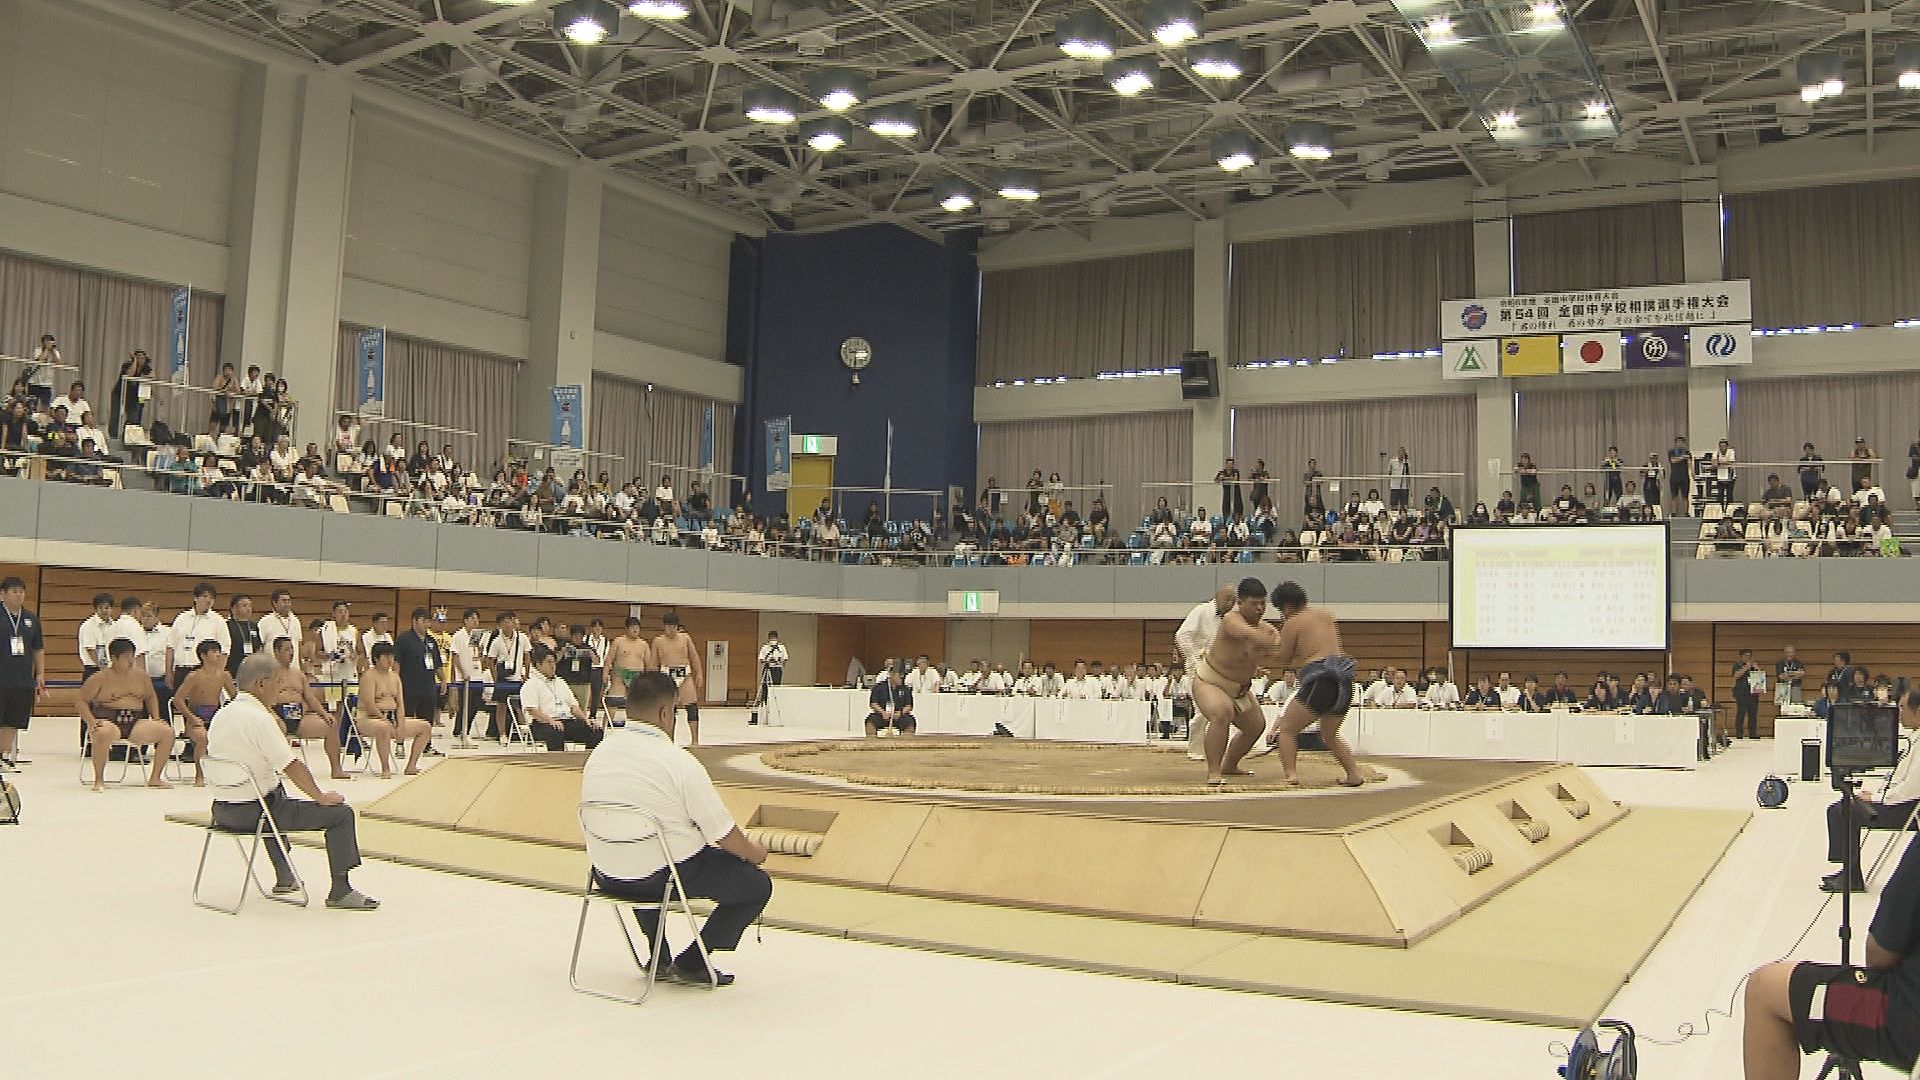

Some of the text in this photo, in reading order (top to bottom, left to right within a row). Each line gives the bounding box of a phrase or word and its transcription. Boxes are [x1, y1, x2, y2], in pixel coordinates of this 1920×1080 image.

[1500, 294, 1729, 322] 第54回 全国中学校相撲選手権大会
